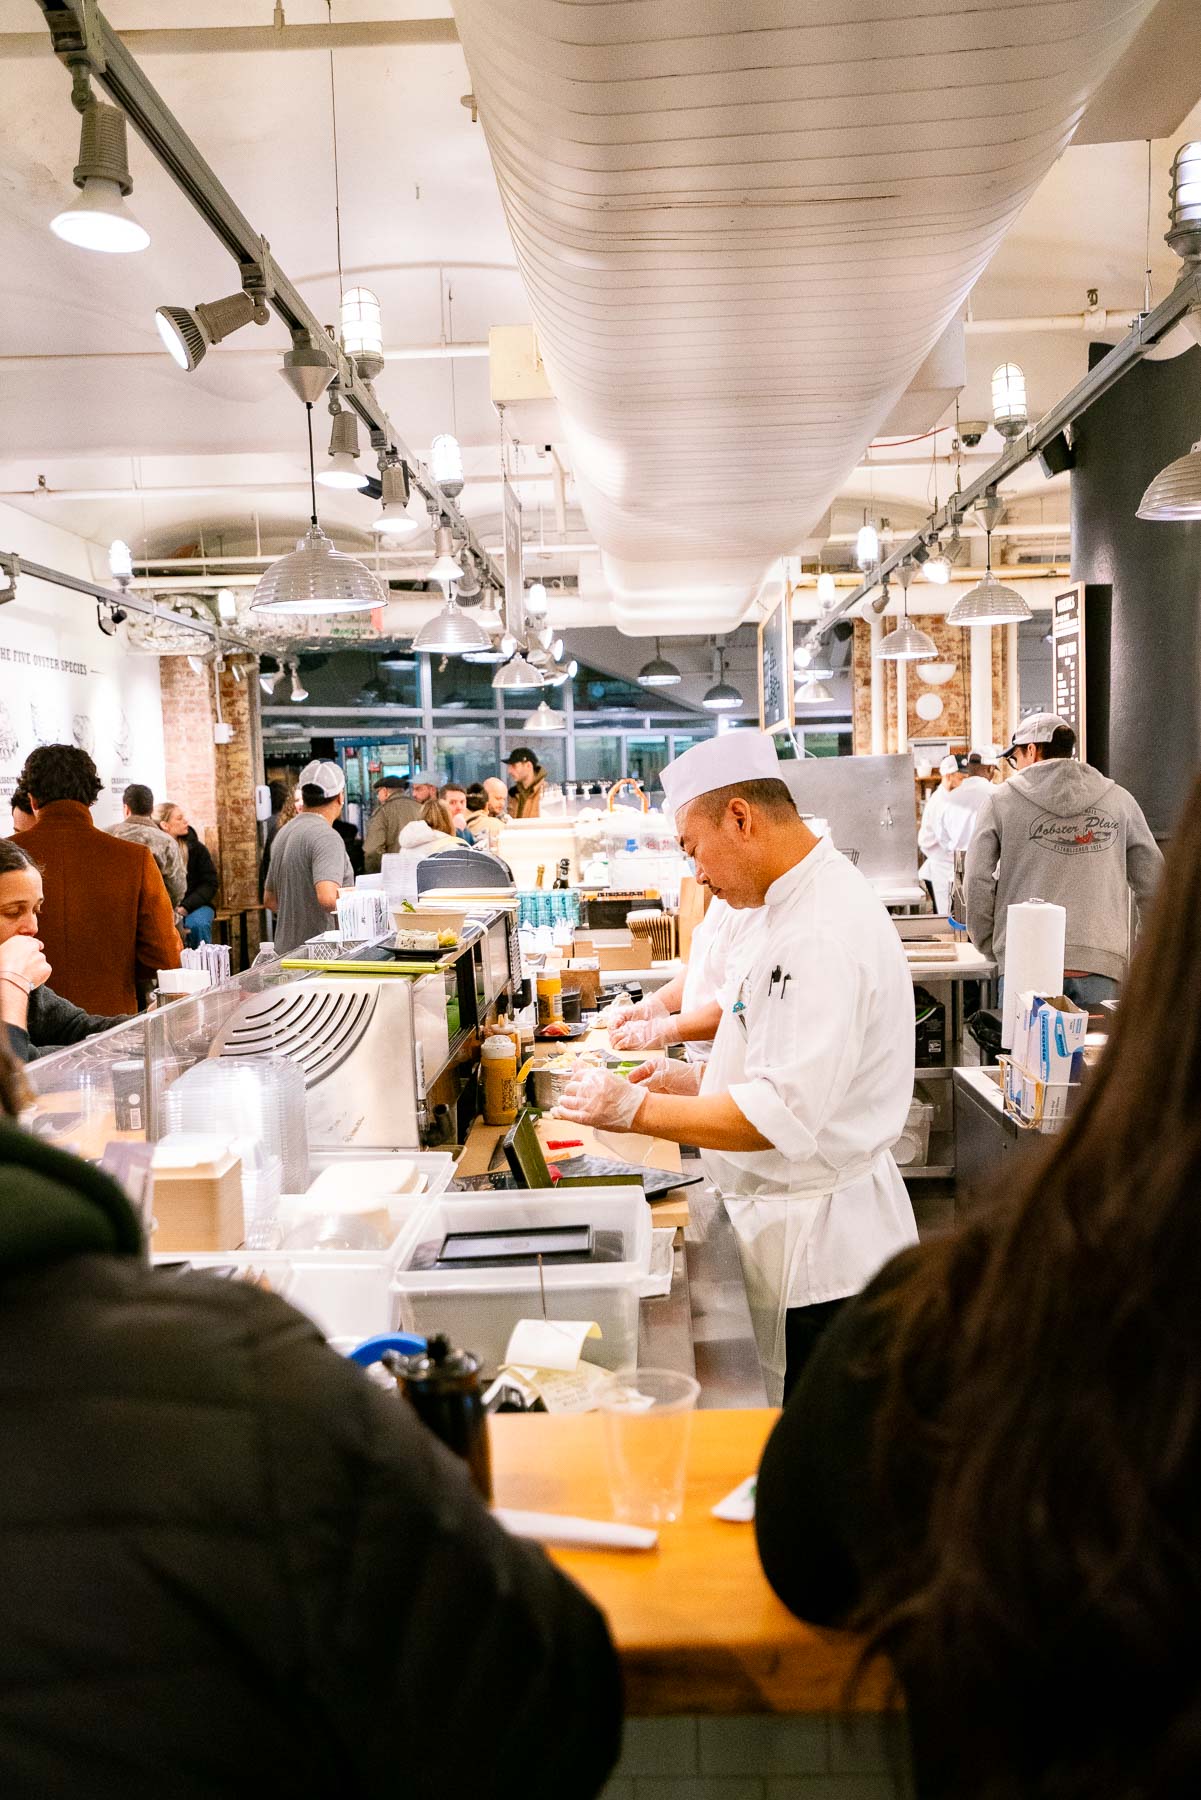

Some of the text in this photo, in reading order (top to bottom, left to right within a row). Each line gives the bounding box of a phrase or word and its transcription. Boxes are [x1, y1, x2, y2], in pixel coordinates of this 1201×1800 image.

[0, 647, 11, 661] HE
[13, 650, 31, 664] FIVE
[60, 660, 87, 676] SPECIES
[1029, 816, 1119, 840] Lobster Place
